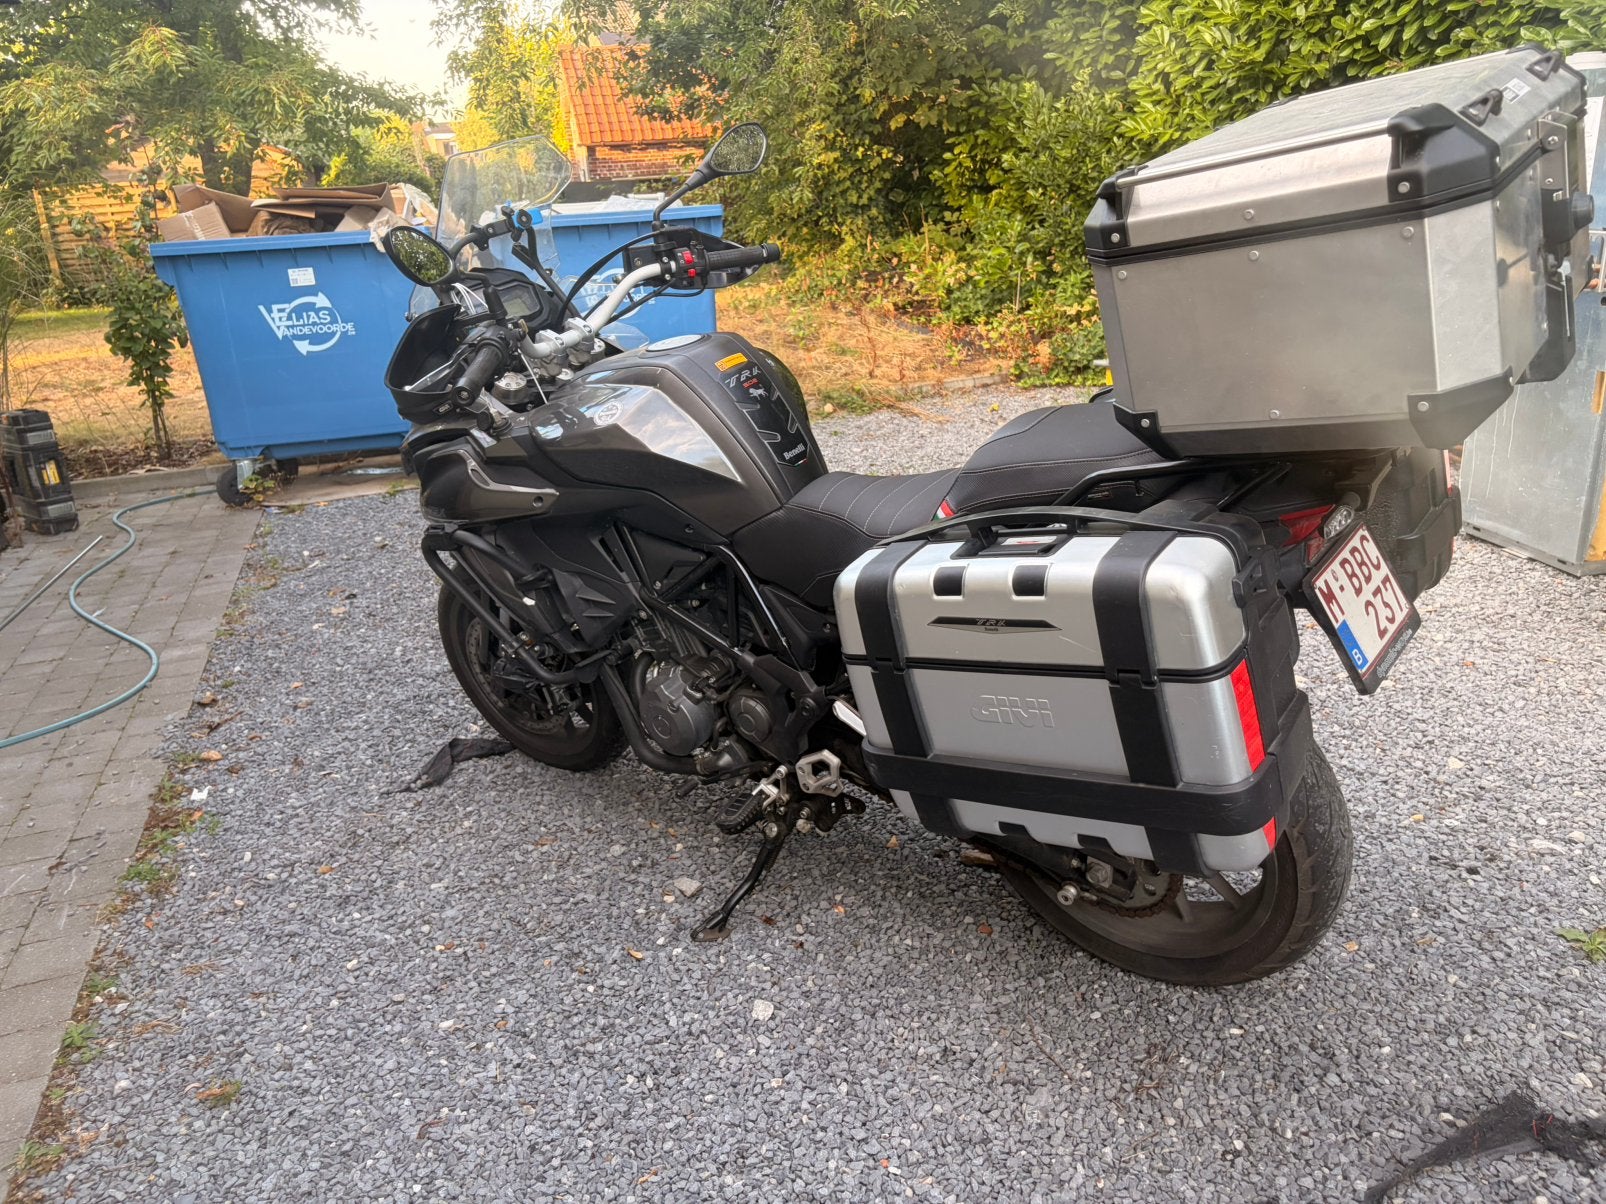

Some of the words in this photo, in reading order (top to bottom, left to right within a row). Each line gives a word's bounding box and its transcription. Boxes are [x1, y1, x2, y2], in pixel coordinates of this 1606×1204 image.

[725, 366, 760, 388] TRK
[783, 442, 805, 460] Benelli
[1364, 573, 1404, 641] 237
[1352, 649, 1364, 665] B
[970, 694, 1055, 728] GIVI
